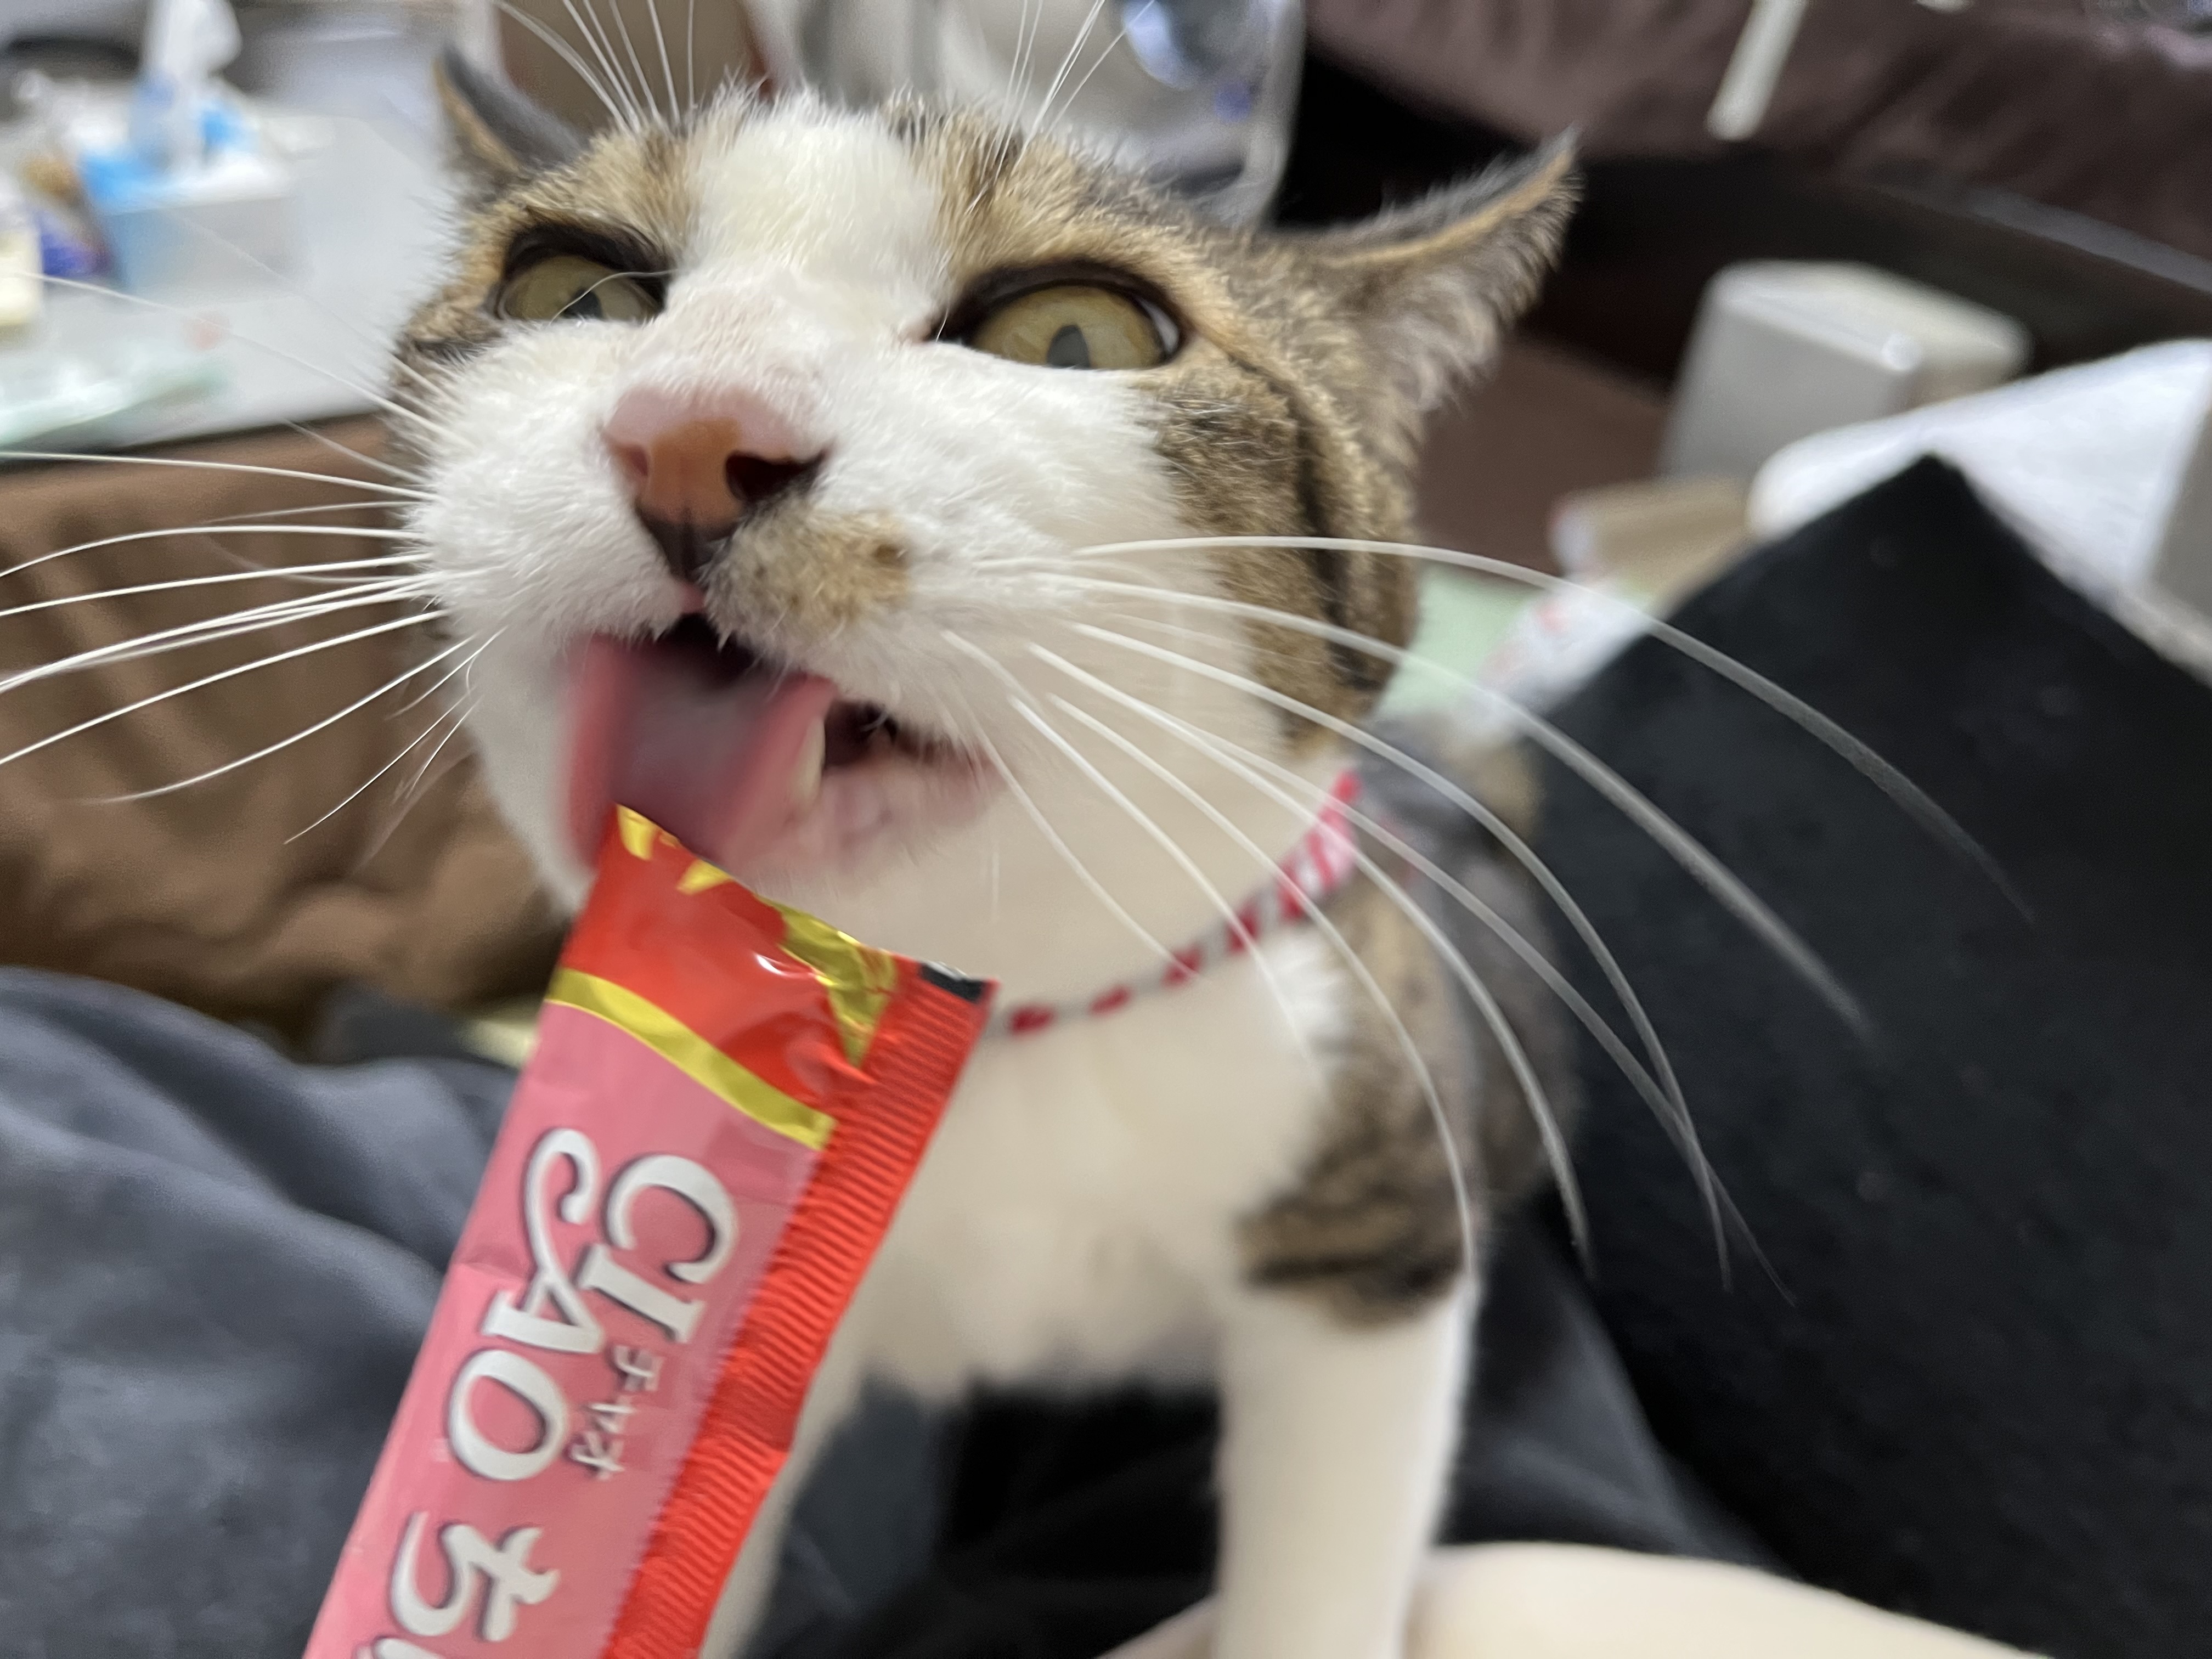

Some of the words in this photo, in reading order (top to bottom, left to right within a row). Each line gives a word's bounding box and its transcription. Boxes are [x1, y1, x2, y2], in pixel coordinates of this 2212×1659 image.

[449, 1128, 739, 1480] CIAO
[572, 1345, 664, 1480] チャオ
[358, 1511, 561, 1659] ち
